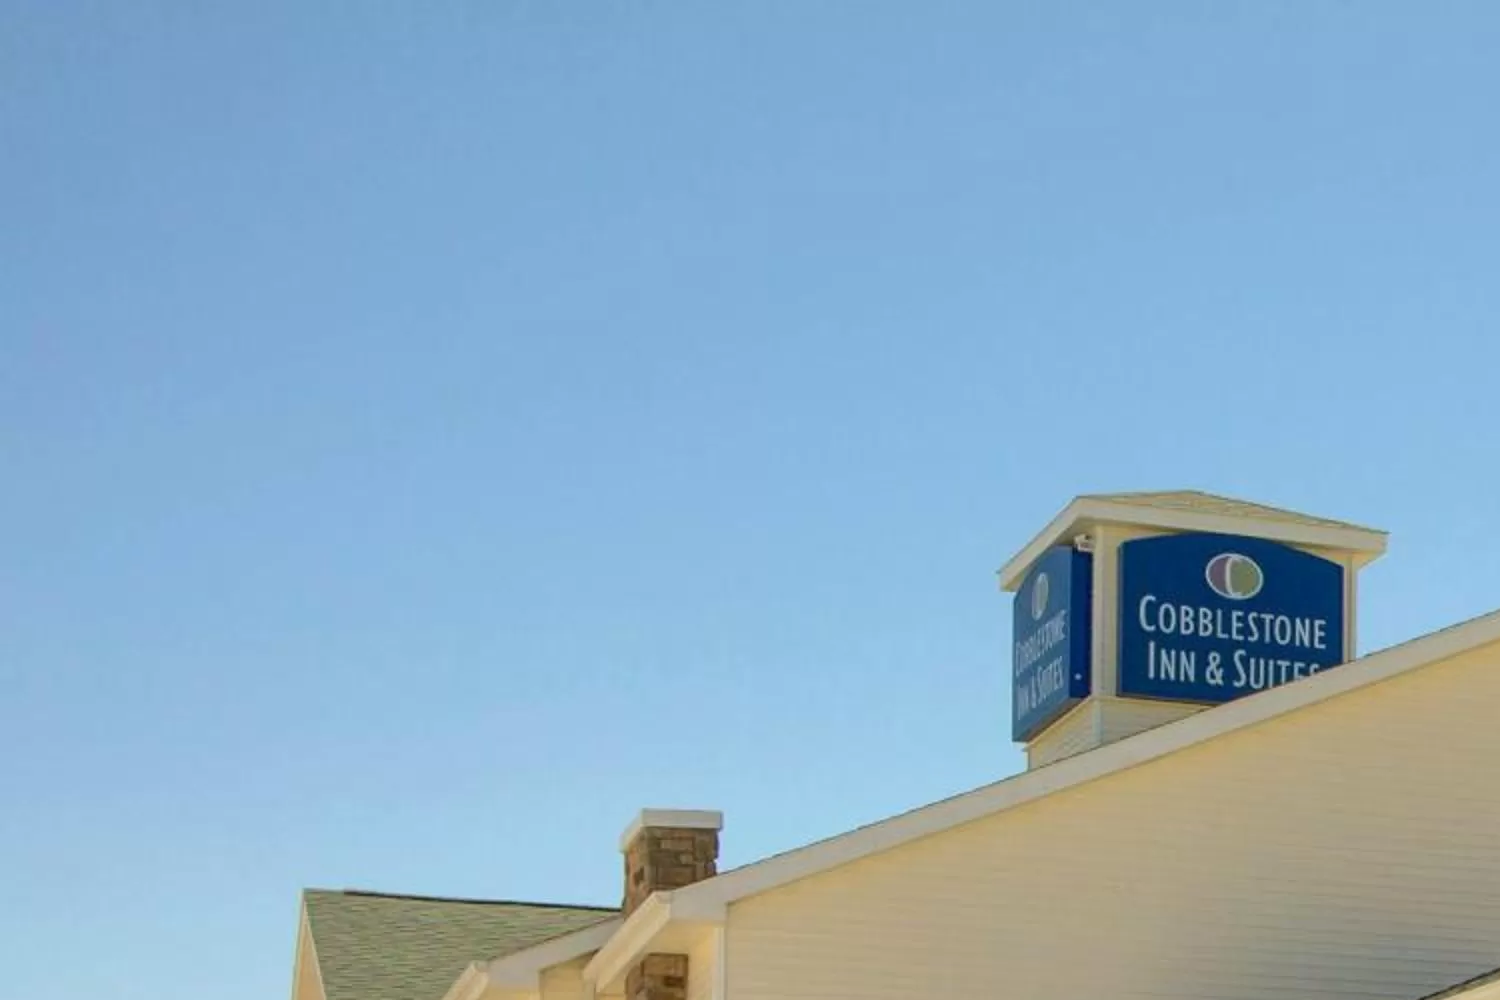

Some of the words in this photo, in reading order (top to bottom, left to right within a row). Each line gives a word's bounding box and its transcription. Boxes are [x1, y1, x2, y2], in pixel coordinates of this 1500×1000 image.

[1139, 594, 1327, 649] COBBLESTONE
[1148, 640, 1195, 682] INN
[1205, 650, 1224, 686] &
